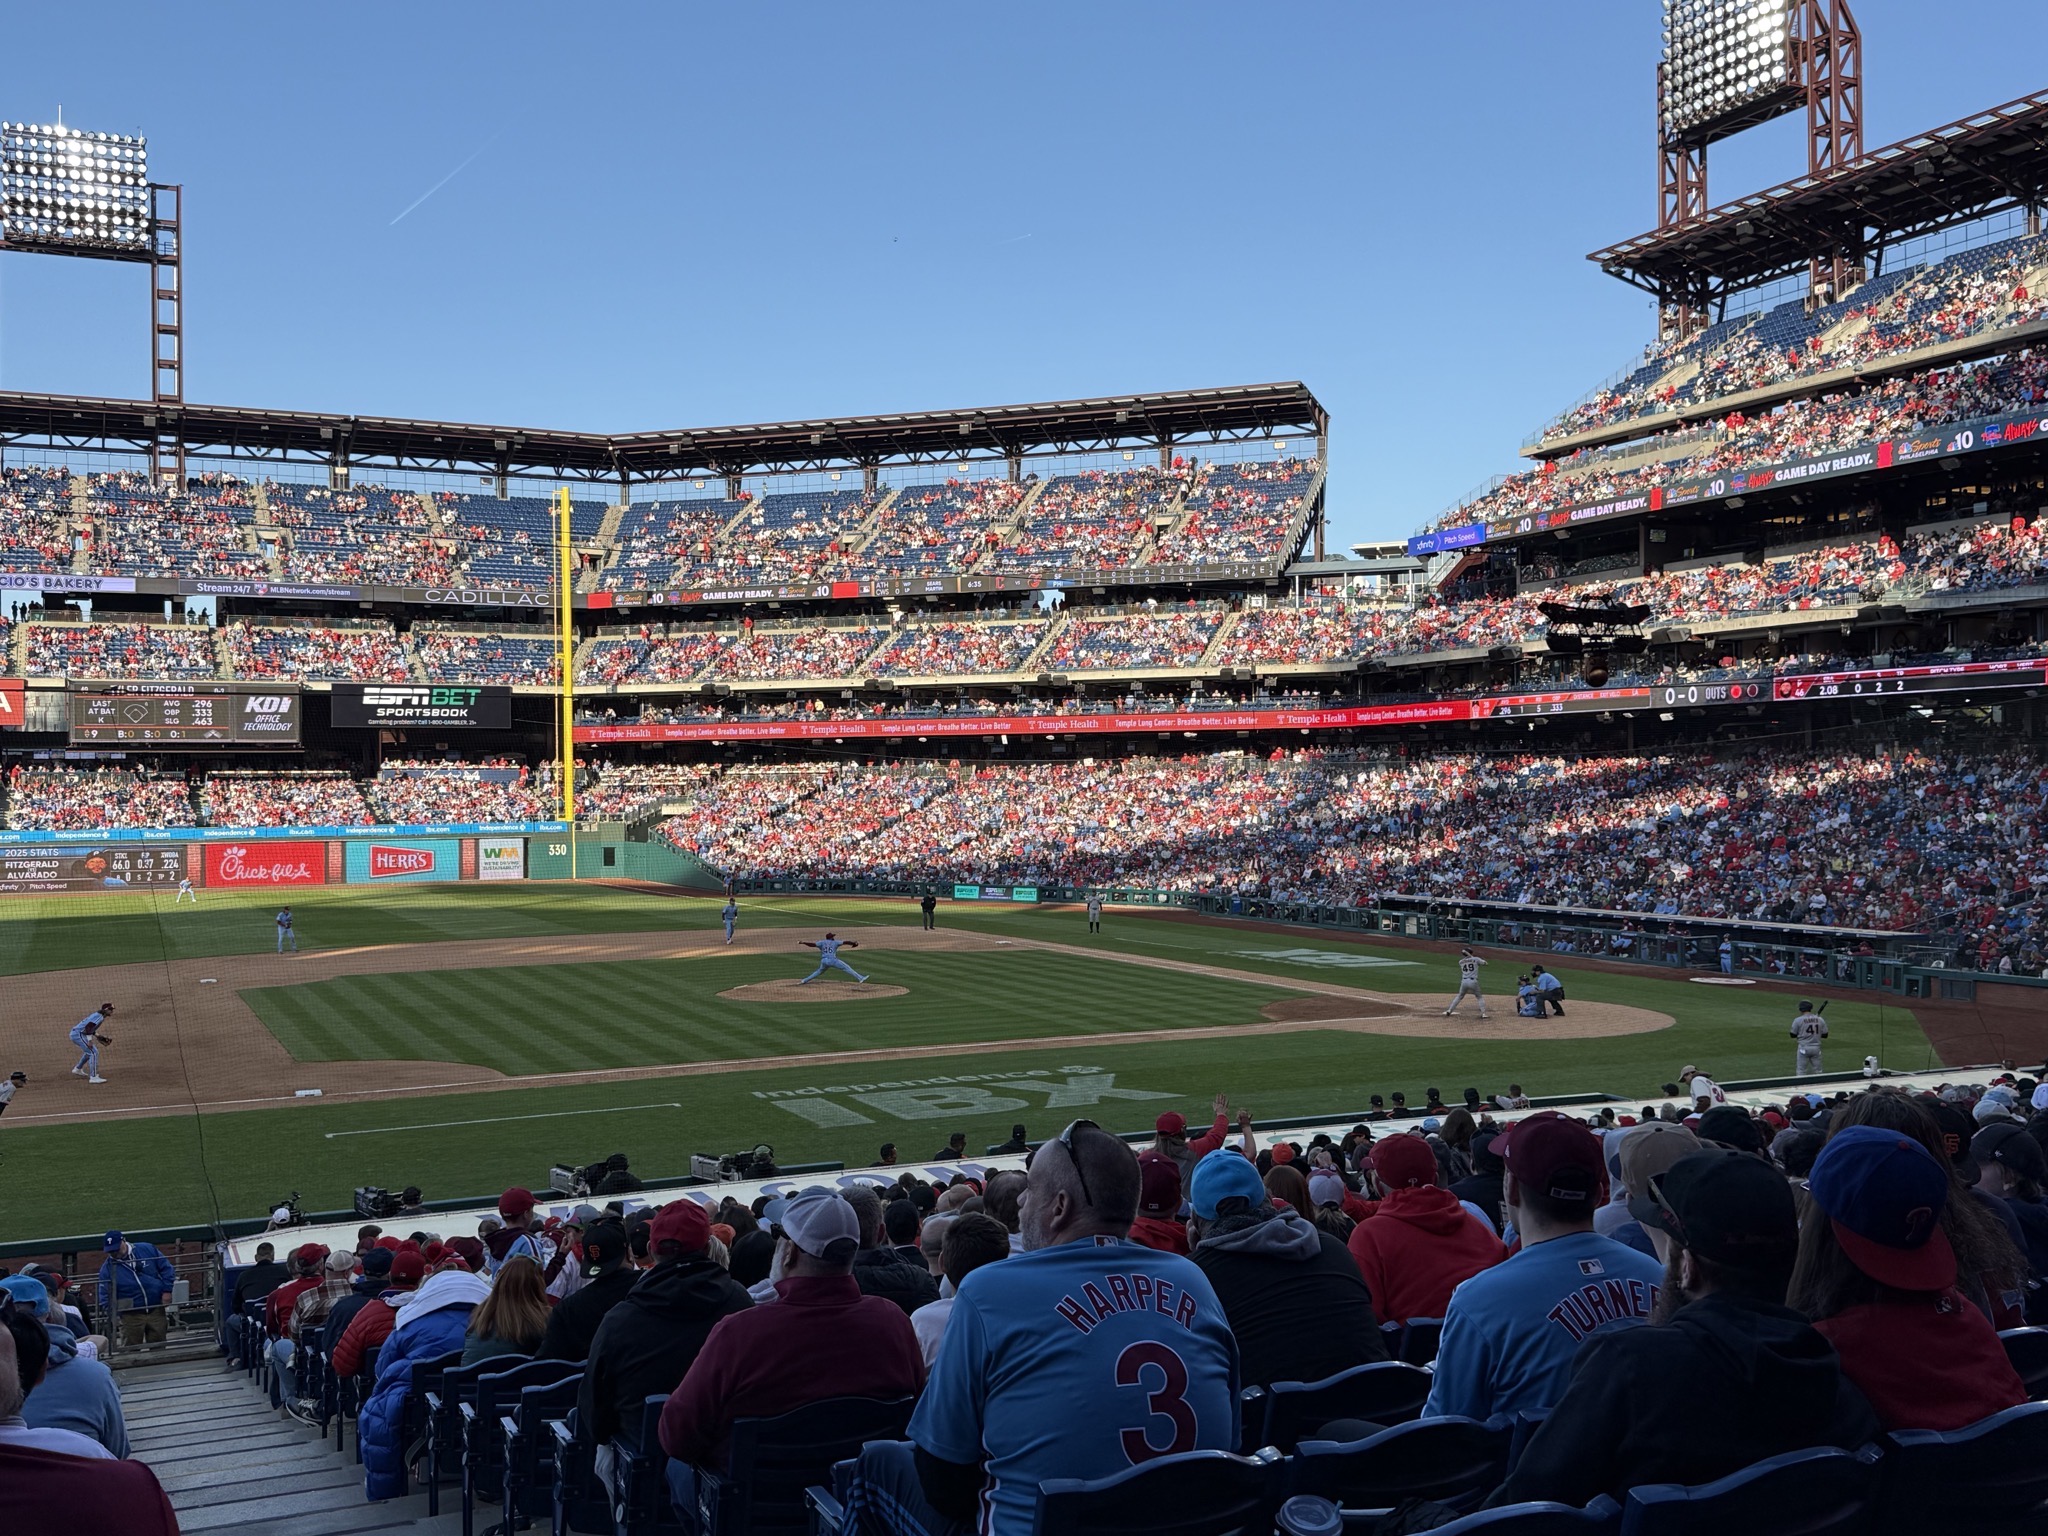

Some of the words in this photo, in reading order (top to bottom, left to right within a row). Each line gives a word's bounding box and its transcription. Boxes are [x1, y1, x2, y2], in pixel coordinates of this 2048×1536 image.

[1911, 438, 1941, 453] Sports
[1955, 430, 1973, 449] 10
[1899, 448, 1938, 461] PHILADELPHIA
[1775, 466, 1807, 482] GAME
[1808, 461, 1831, 476] DAY
[1833, 452, 1873, 471] READY.
[1676, 485, 1700, 497] Sports
[1710, 478, 1725, 495] 10
[1666, 493, 1698, 505] PHILADELPHIA
[1570, 506, 1596, 521] GAME
[1597, 503, 1615, 518] DAY
[1615, 497, 1647, 514] READY.
[1520, 518, 1531, 533] 10
[1416, 539, 1434, 551] xfinity
[1444, 535, 1457, 545] Pitch
[1458, 531, 1475, 543] Speed
[44, 577, 104, 590] BAKERY
[197, 583, 231, 593] Stream
[233, 584, 251, 594] 24/7
[270, 586, 350, 596] MLBNetwork.com/stream
[703, 592, 727, 600] GAME
[728, 591, 744, 599] DAY
[745, 590, 774, 598] READY.
[817, 585, 829, 597] 10
[895, 587, 900, 595] 0
[425, 590, 550, 606] CADILLAC
[652, 593, 664, 604] 10
[1705, 686, 1726, 699] OUTS
[1794, 689, 1804, 697] 46
[1819, 686, 1838, 695] 2.08
[1854, 683, 1862, 693] 0
[1875, 682, 1882, 692] 2
[1897, 681, 1904, 690] 2
[362, 687, 430, 705] ESPN
[431, 688, 482, 706] BET
[192, 700, 213, 708] .296
[244, 697, 292, 713] KDI
[1499, 707, 1511, 715] .296
[1536, 705, 1542, 713] 5
[192, 709, 213, 717] .333
[376, 708, 468, 717] SPORTSBOOK
[1286, 714, 1320, 725] Temple
[1322, 712, 1347, 723] Health
[1357, 712, 1371, 722] Temple
[1371, 711, 1381, 721] Lung
[1396, 709, 1413, 718] Breathe
[1428, 707, 1438, 716] Live
[1439, 706, 1453, 715] Better
[192, 718, 213, 726] .463
[254, 715, 281, 723] OFFICE
[1037, 720, 1067, 731] Temple
[1070, 719, 1099, 728] Health
[1115, 719, 1136, 728] Temple
[1137, 719, 1152, 728] Lung
[1153, 718, 1176, 726] Center:
[1177, 717, 1200, 726] Breathe
[1223, 716, 1236, 724] Live
[1238, 716, 1258, 725] Better
[243, 722, 293, 731] TECHNOLOGY
[665, 728, 682, 737] Temple
[683, 728, 697, 737] Lung
[698, 727, 717, 736] Center:
[717, 727, 738, 735] Breathe
[809, 725, 837, 735] Temple
[840, 724, 866, 733] Health
[881, 724, 900, 733] Temple
[902, 724, 915, 733] Lung
[916, 723, 937, 732] Center:
[937, 723, 959, 731] Breathe
[980, 722, 992, 730] Live
[993, 722, 1011, 730] Better
[91, 730, 98, 738] 9
[598, 729, 622, 739] Temple
[626, 728, 651, 738] Health
[5, 849, 28, 857] 2025
[30, 849, 59, 857] STATS
[483, 847, 519, 858] WM
[548, 844, 567, 856] 330
[5, 861, 59, 869] FITZGERALD
[112, 860, 130, 870] 66.0
[137, 859, 153, 869] 0.37
[161, 859, 179, 868] .224
[220, 849, 311, 881] Chick-fil-A
[376, 853, 427, 870] HERR'S
[7, 871, 58, 880] ALVARADO
[125, 872, 131, 882] 0
[147, 872, 152, 881] 2
[169, 872, 175, 881] 2
[46, 883, 68, 891] Speed
[823, 946, 834, 954] 46
[1462, 963, 1475, 972] 49
[1806, 1024, 1819, 1035] 41
[751, 1069, 1051, 1099] Independence
[770, 1073, 1188, 1129] IBX
[1054, 1273, 1198, 1336] HARPER
[1114, 1339, 1199, 1466] 3
